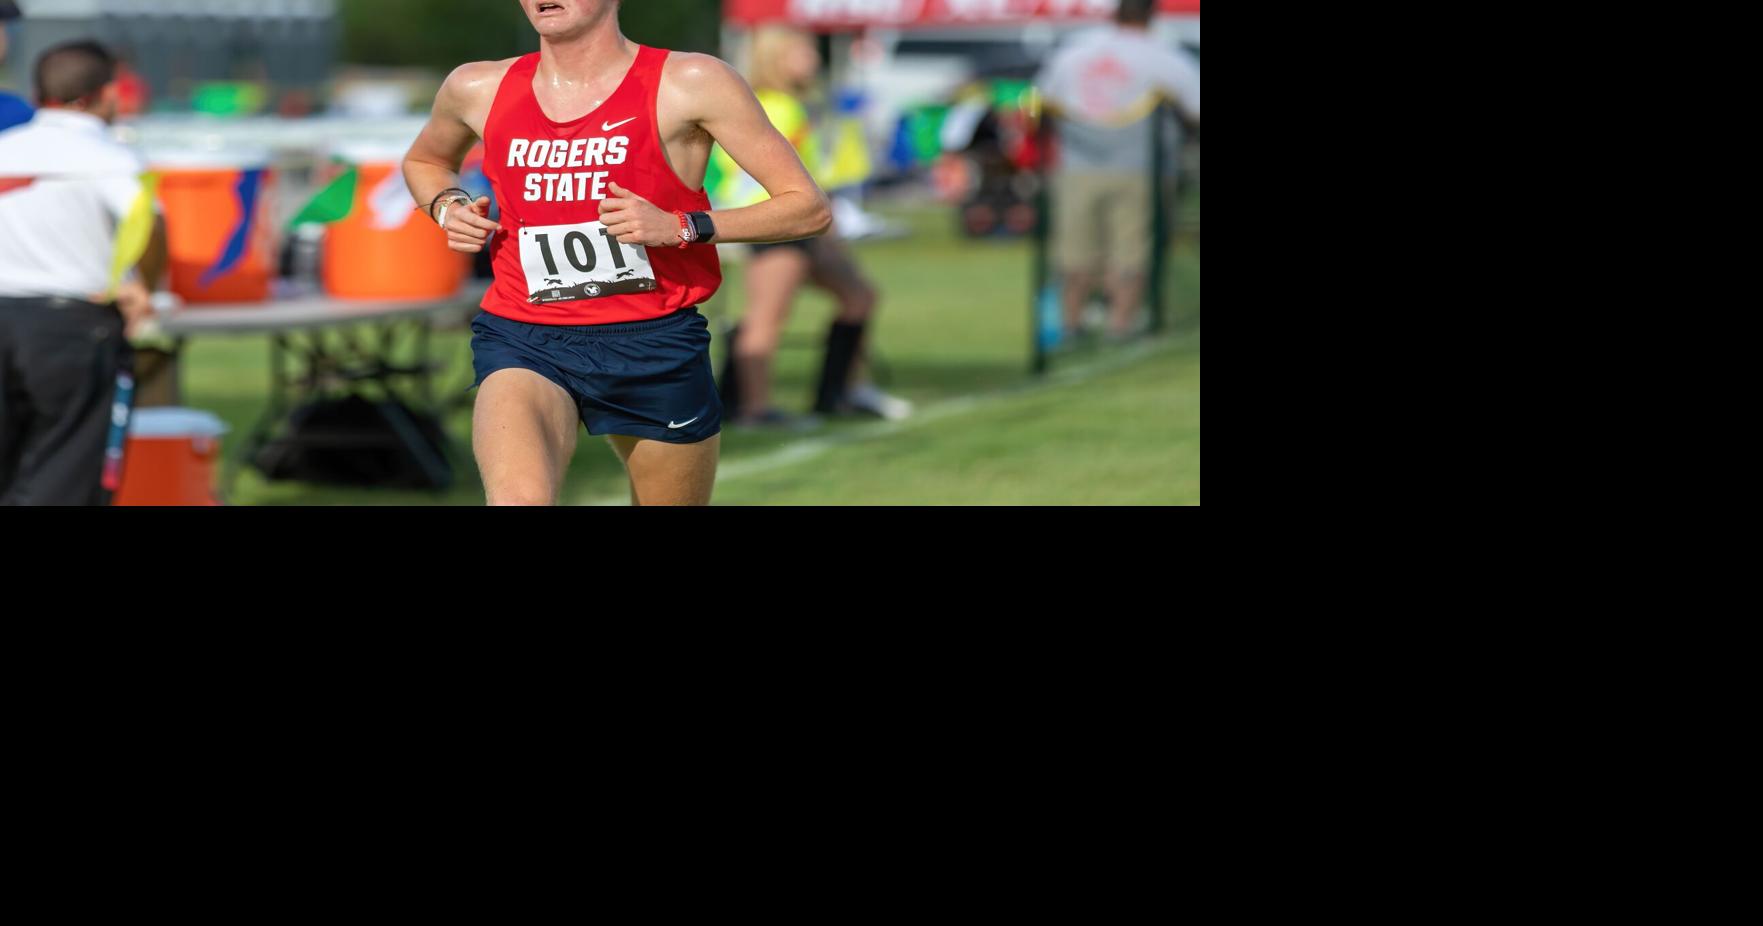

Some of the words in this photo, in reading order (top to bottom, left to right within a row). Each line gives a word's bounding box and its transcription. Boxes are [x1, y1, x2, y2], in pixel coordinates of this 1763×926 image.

[507, 136, 629, 168] ROGERS
[523, 171, 609, 201] STATE
[535, 228, 627, 275] 101
